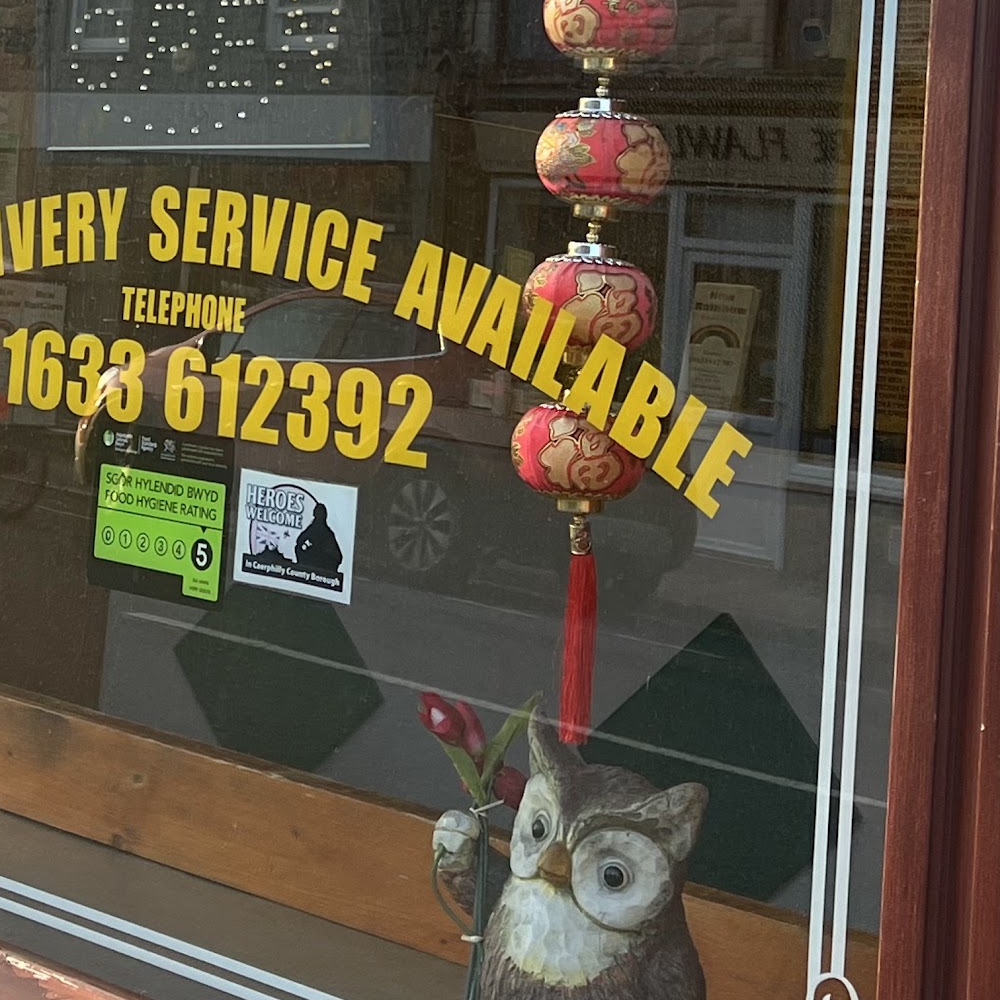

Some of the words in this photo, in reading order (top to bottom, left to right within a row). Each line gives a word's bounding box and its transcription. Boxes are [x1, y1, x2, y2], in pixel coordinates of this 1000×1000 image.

[121, 286, 246, 334] TELEPHONE
[149, 185, 384, 304] SERVICE
[394, 242, 751, 518] AVAILABLE
[164, 346, 433, 469] 612392
[104, 489, 134, 506] FOOD
[135, 496, 178, 515] HYGIENE
[179, 503, 217, 522] RATING
[134, 478, 184, 498] HYLENDID
[186, 487, 220, 503] BWYD
[246, 483, 305, 514] HEROES
[245, 503, 303, 529] WELCOME
[252, 561, 285, 576] Caerphilly
[286, 567, 311, 581] County
[310, 573, 340, 588] Borough
